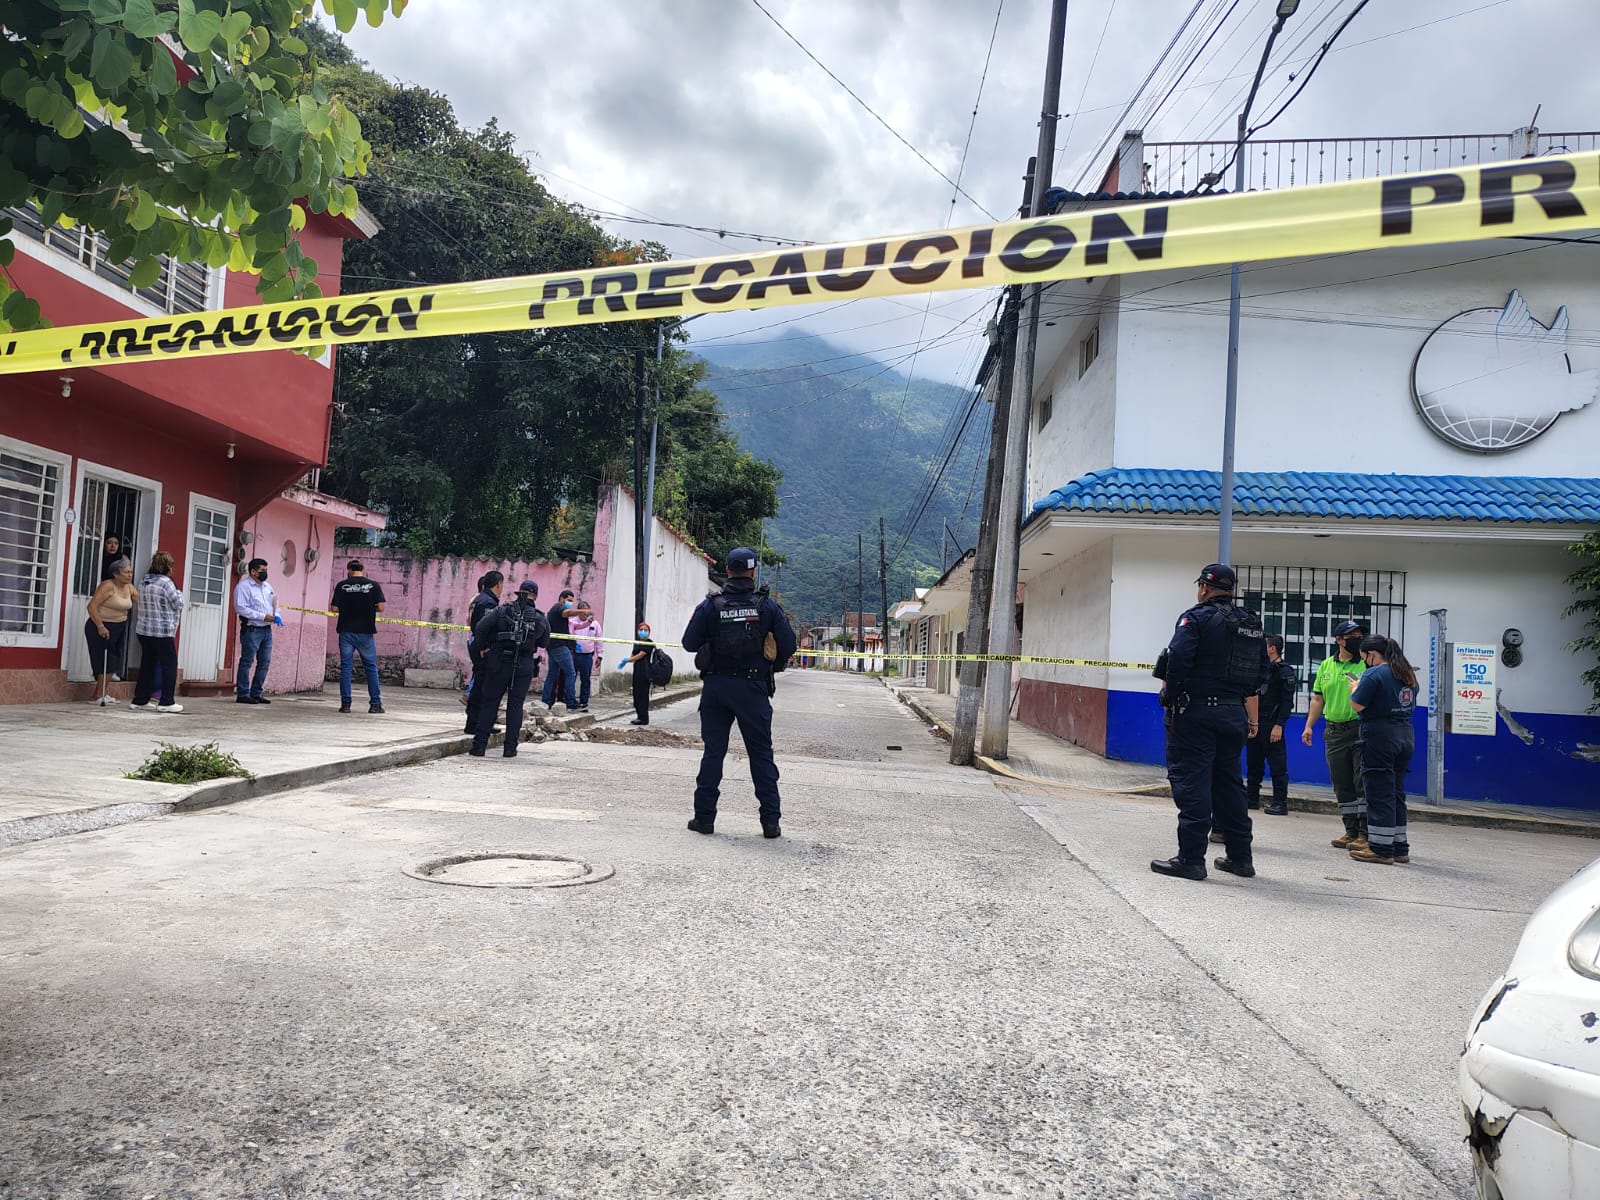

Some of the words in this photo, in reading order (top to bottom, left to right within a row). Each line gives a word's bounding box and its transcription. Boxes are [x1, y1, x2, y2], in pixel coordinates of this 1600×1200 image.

[1380, 155, 1600, 237] PR
[528, 206, 1169, 320] PRECAUCIÓN
[61, 294, 434, 363] PRECAUCIÓN
[165, 504, 175, 515] 20
[1030, 657, 1074, 665] PRECAUCION
[1084, 660, 1128, 668] PRECAUCION
[1462, 664, 1487, 675] 150
[1457, 690, 1483, 700] $499
